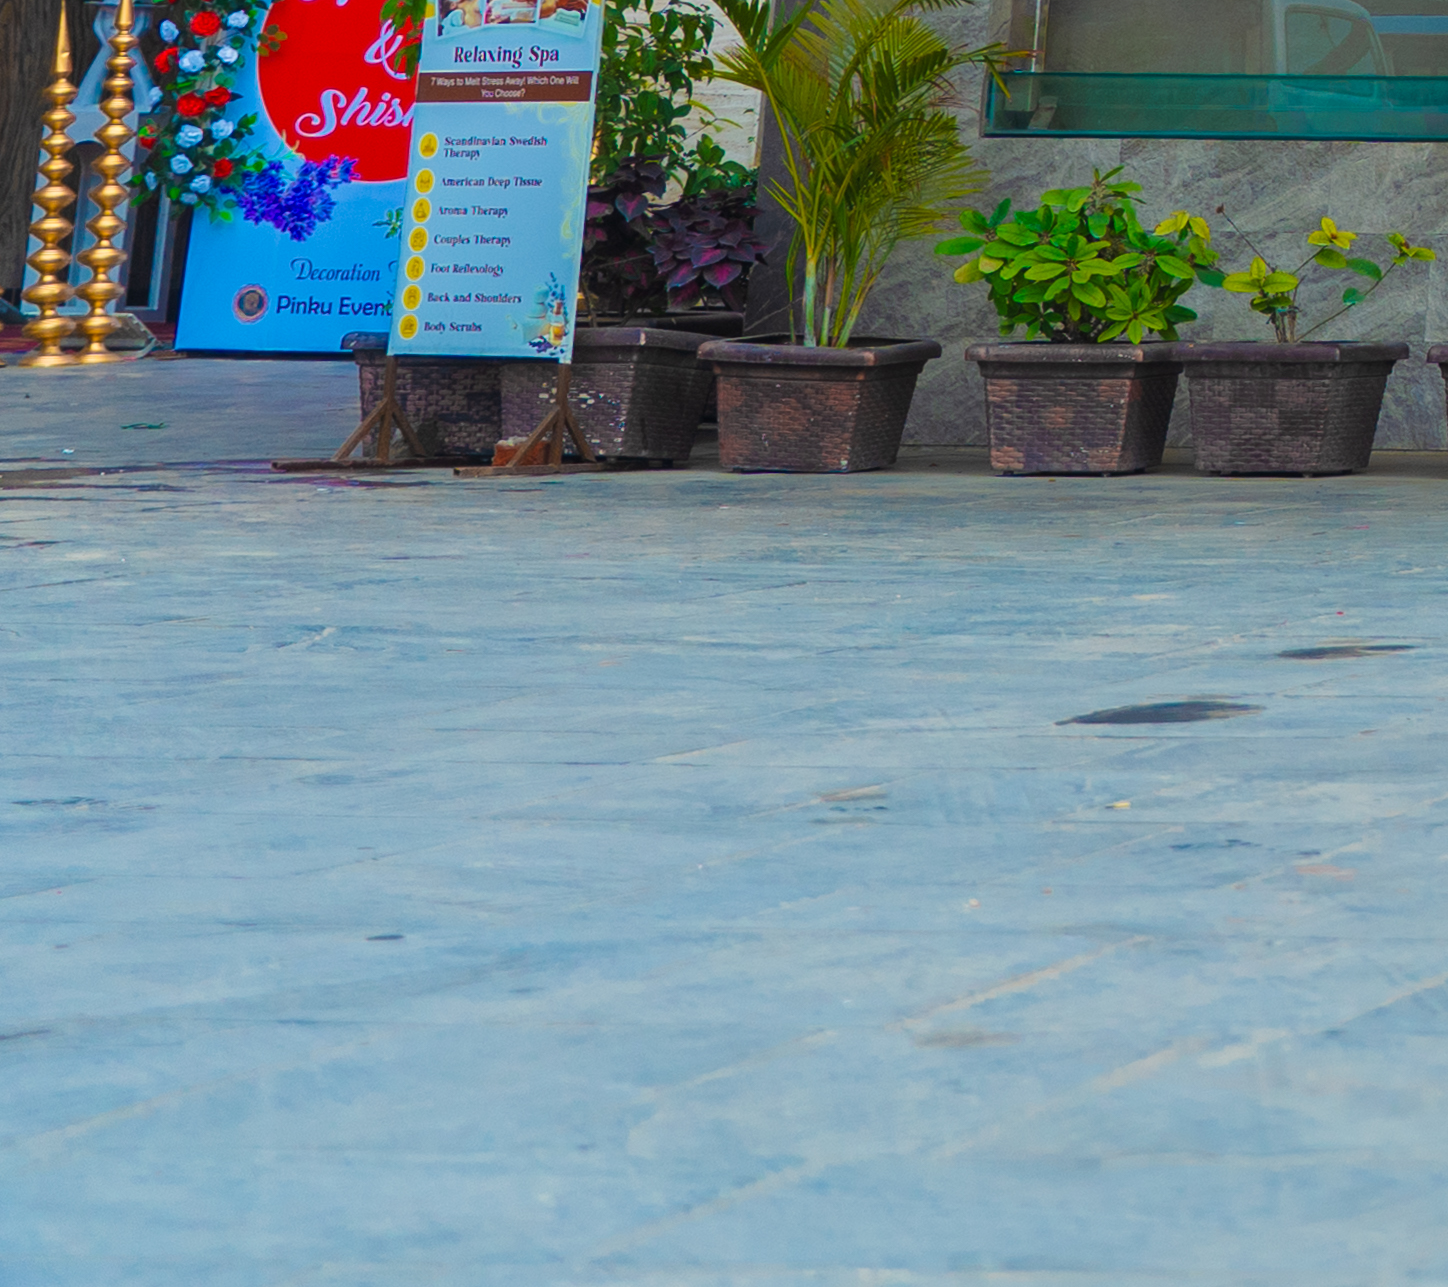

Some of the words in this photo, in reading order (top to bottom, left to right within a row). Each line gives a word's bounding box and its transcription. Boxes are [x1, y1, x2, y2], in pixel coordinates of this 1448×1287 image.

[364, 18, 409, 81] &
[454, 45, 524, 69] Relaxing
[528, 45, 560, 67] Spa
[435, 77, 455, 87] Ways
[456, 77, 464, 86] to
[464, 77, 480, 86] Melt
[481, 77, 504, 86] Stress
[505, 76, 526, 87] Away!
[527, 76, 549, 85] Which
[549, 76, 564, 85] One
[565, 75, 580, 85] Will
[481, 89, 494, 97] You
[494, 88, 526, 98] Choose?
[444, 136, 506, 146] Scandinavian
[509, 136, 548, 146] Swedish
[443, 148, 480, 160] Therapy
[442, 177, 486, 187] American
[488, 177, 510, 189] Deep
[514, 177, 543, 187] Tissue
[438, 206, 468, 215] Aroma
[471, 205, 508, 218] Therapy
[433, 234, 471, 247] Couples
[474, 234, 511, 248] Therapy
[289, 257, 381, 282] Decoration
[430, 263, 450, 273] Foot
[452, 263, 504, 277] Reflexology
[427, 292, 450, 302] Back
[453, 293, 472, 302] and
[474, 292, 522, 303] Shoulders
[276, 295, 333, 314] Pinku
[424, 322, 446, 334] Body
[449, 322, 482, 332] Scrubs
